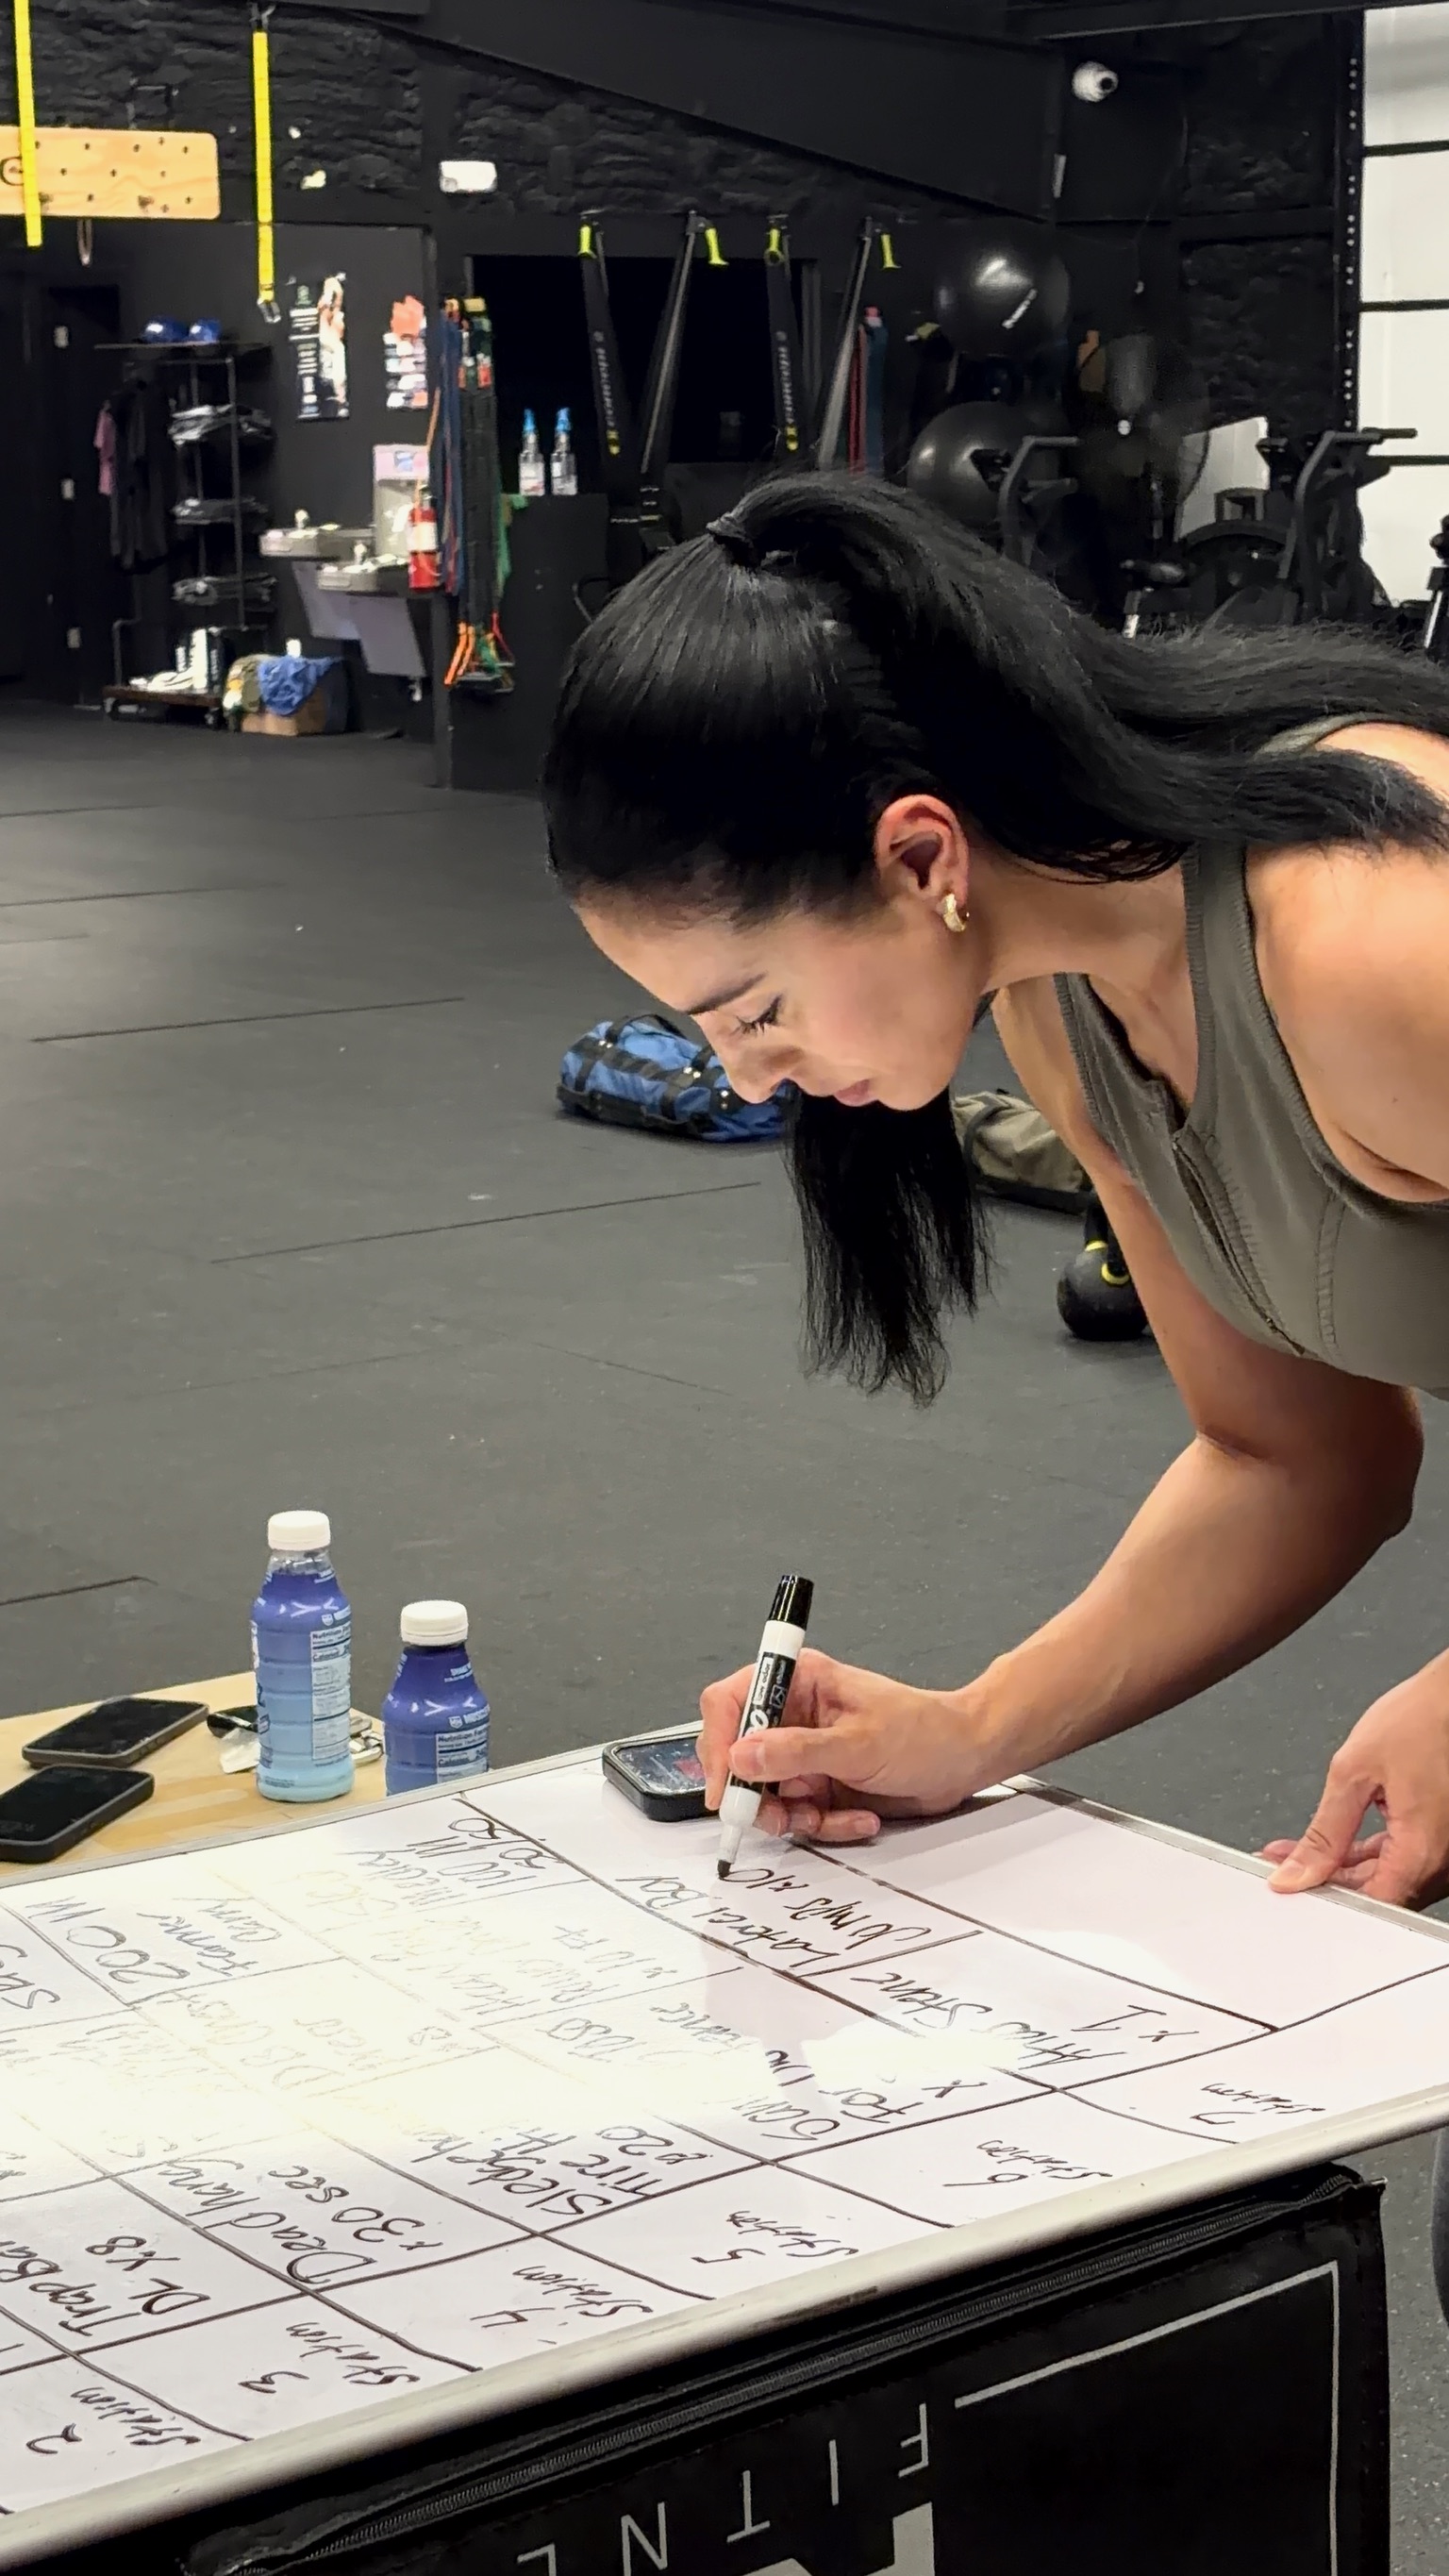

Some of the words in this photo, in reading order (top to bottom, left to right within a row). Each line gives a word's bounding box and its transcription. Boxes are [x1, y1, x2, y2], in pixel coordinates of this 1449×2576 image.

[66, 1925, 191, 1984] 200
[942, 2173, 1028, 2187] 6
[691, 2249, 766, 2264] 5
[726, 2211, 859, 2257] Station
[512, 2266, 654, 2317] Station
[286, 2322, 420, 2385] Station
[238, 2371, 309, 2394] 3
[25, 2423, 82, 2455] 2
[71, 2387, 201, 2446] Station
